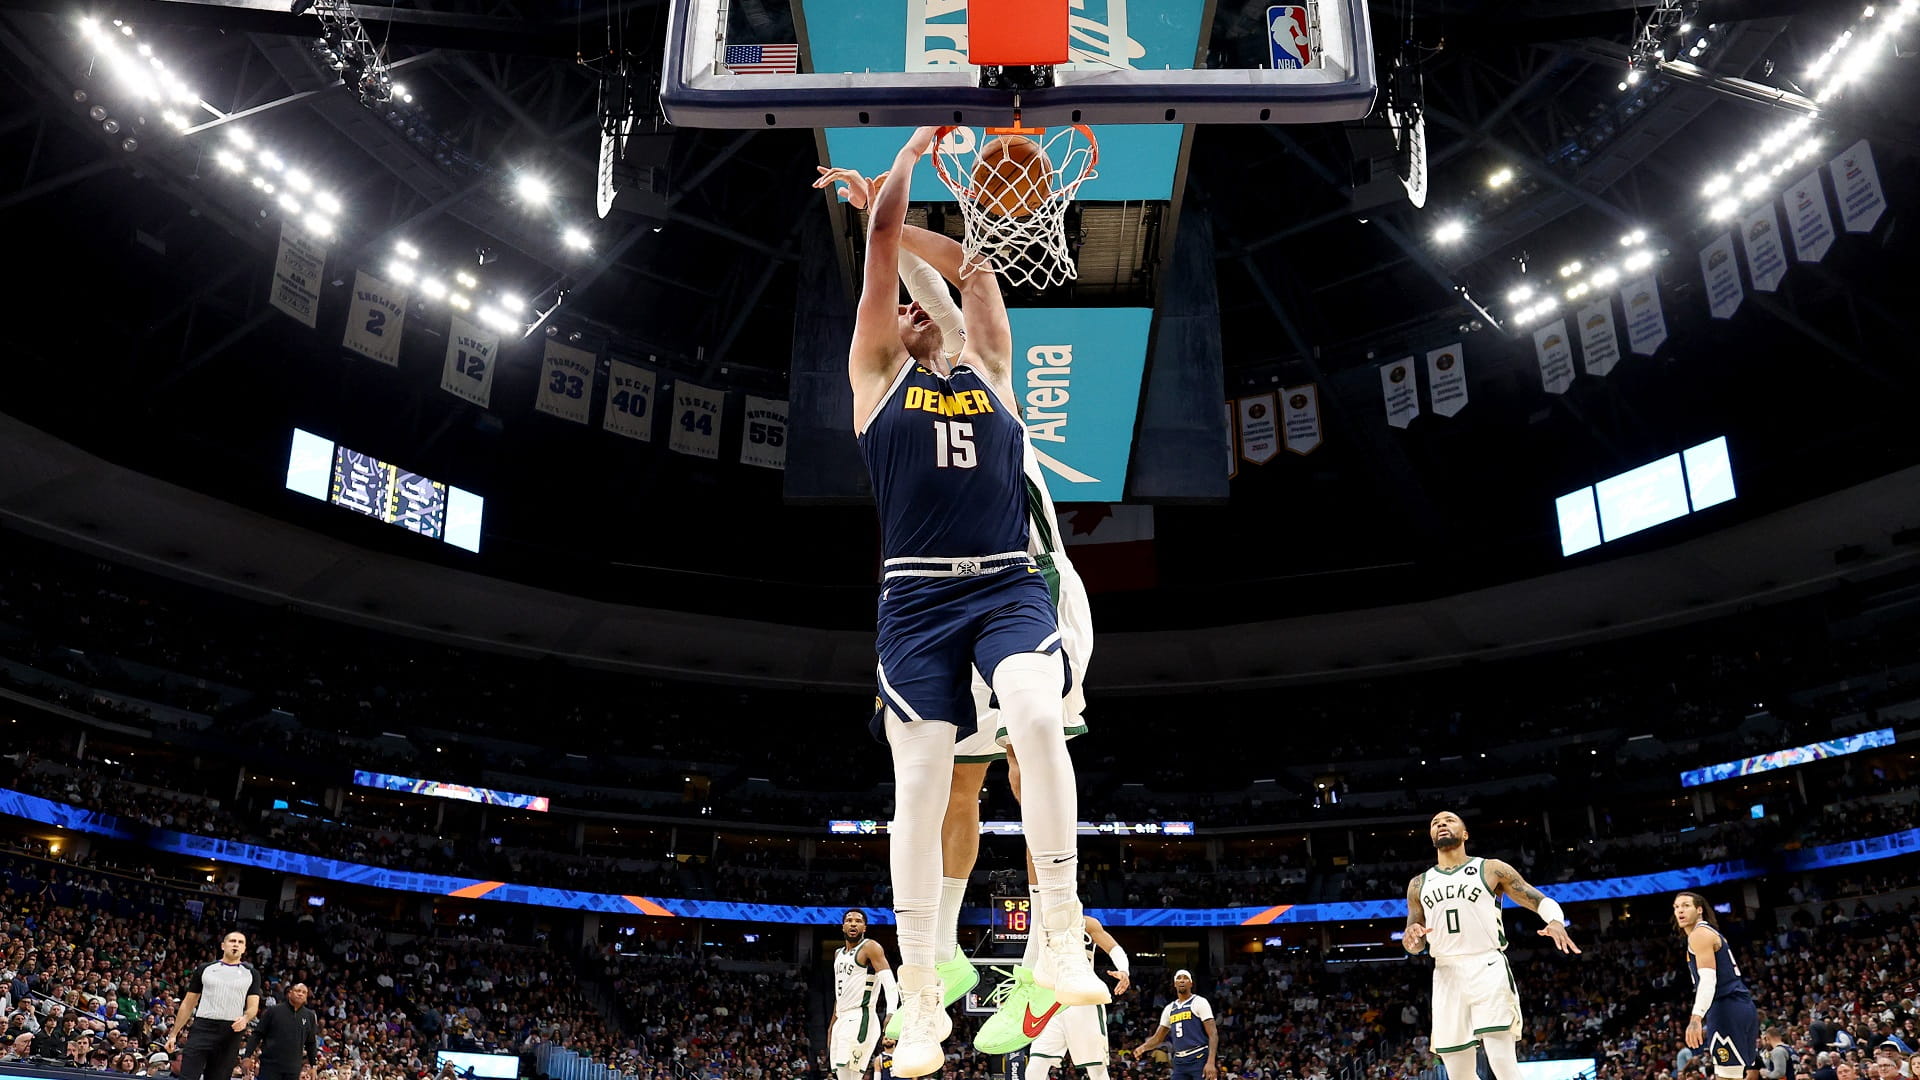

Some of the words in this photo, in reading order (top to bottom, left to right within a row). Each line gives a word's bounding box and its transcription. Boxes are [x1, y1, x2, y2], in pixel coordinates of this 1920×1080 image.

[1277, 58, 1297, 70] NBA
[357, 291, 402, 316] ENGLISH
[366, 309, 386, 337] 2
[458, 336, 488, 357] LEVER
[456, 350, 486, 382] 12
[546, 357, 591, 376] THOMPSON
[549, 370, 584, 399] 33
[614, 377, 651, 394] BECK
[1026, 344, 1073, 443] Arena
[612, 390, 647, 417] 40
[679, 396, 718, 414] ISSEL
[904, 386, 995, 417] DENVER
[680, 410, 713, 435] 44
[749, 422, 784, 447] 55
[933, 420, 978, 469] 15
[1004, 899, 1030, 912] 9:12
[1423, 884, 1482, 909] BUCKS
[1008, 912, 1027, 931] 18
[1446, 908, 1461, 934] 0
[1175, 1021, 1183, 1038] 5
